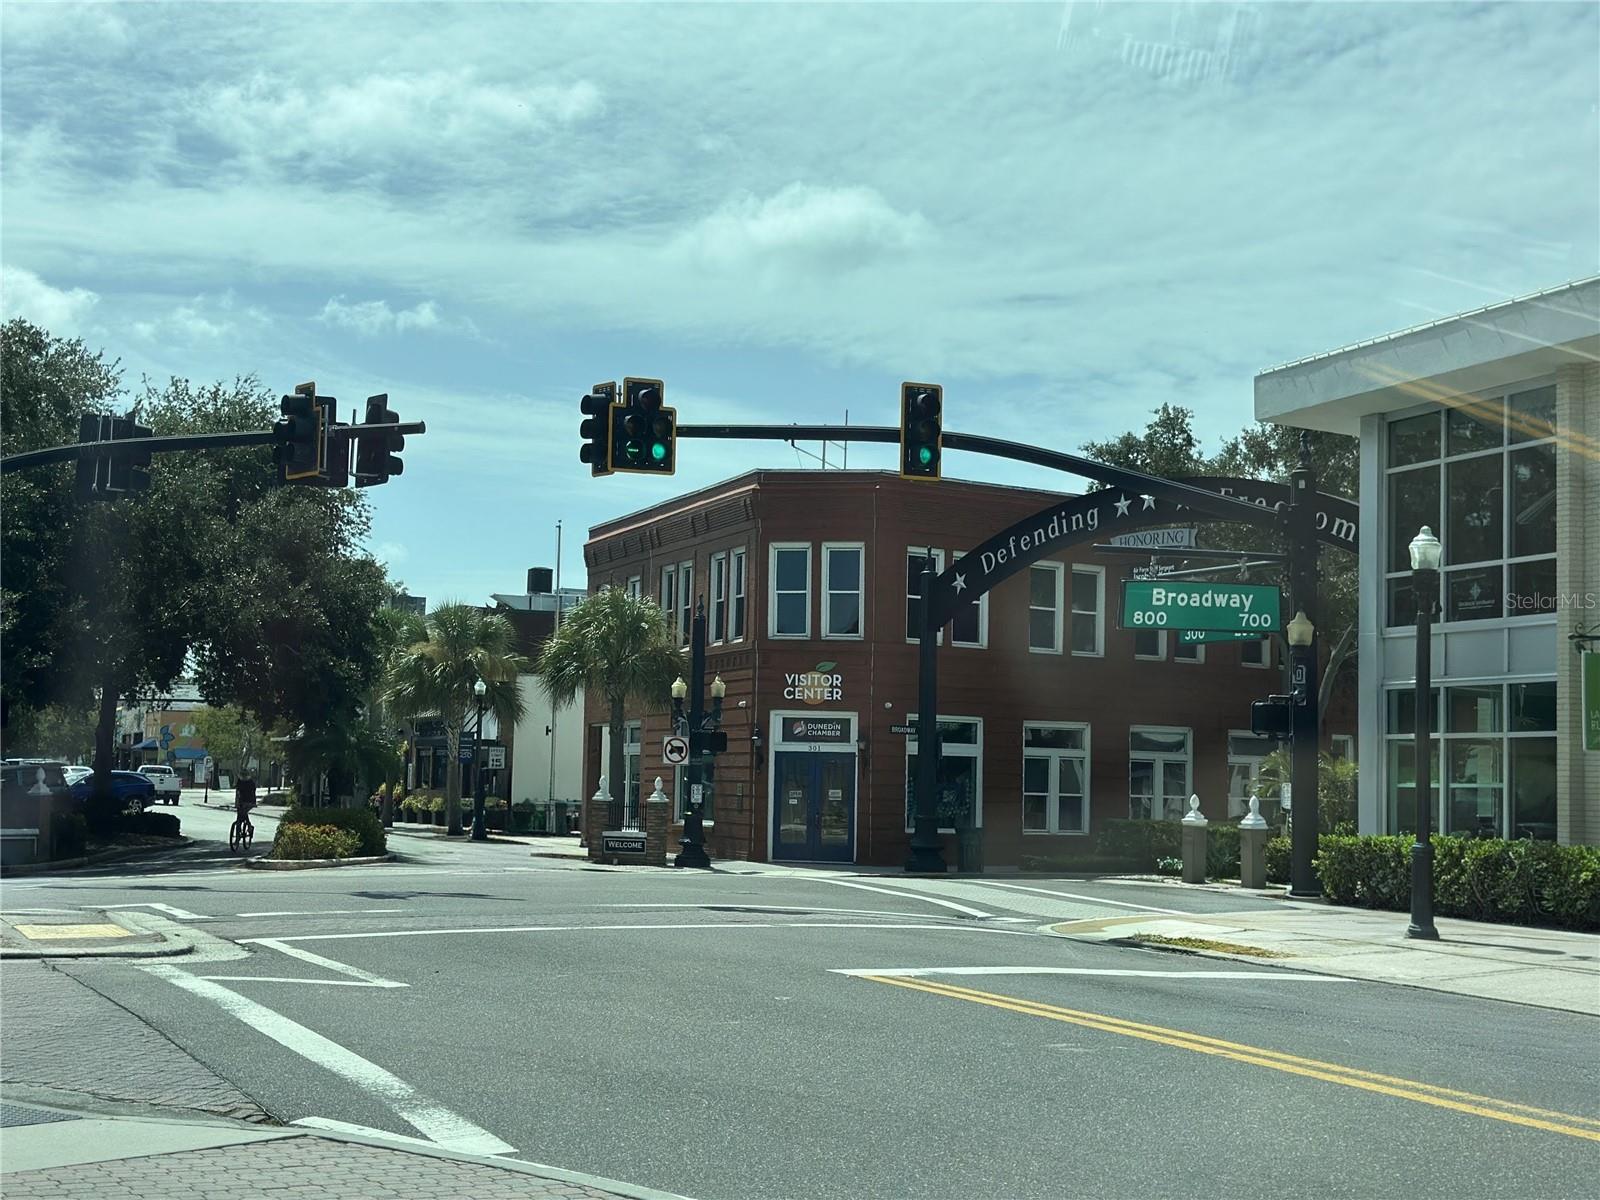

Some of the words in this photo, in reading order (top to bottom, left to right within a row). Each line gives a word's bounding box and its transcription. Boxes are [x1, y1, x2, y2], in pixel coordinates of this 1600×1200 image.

[980, 507, 1099, 575] Defending
[1120, 530, 1184, 547] HONORING
[1151, 587, 1254, 612] Broadway
[1132, 610, 1168, 625] 800
[1238, 613, 1272, 627] 700
[784, 673, 842, 687] VISITOR
[783, 687, 842, 700] CENTER
[491, 758, 502, 767] 15
[608, 840, 643, 849] WELCOME
